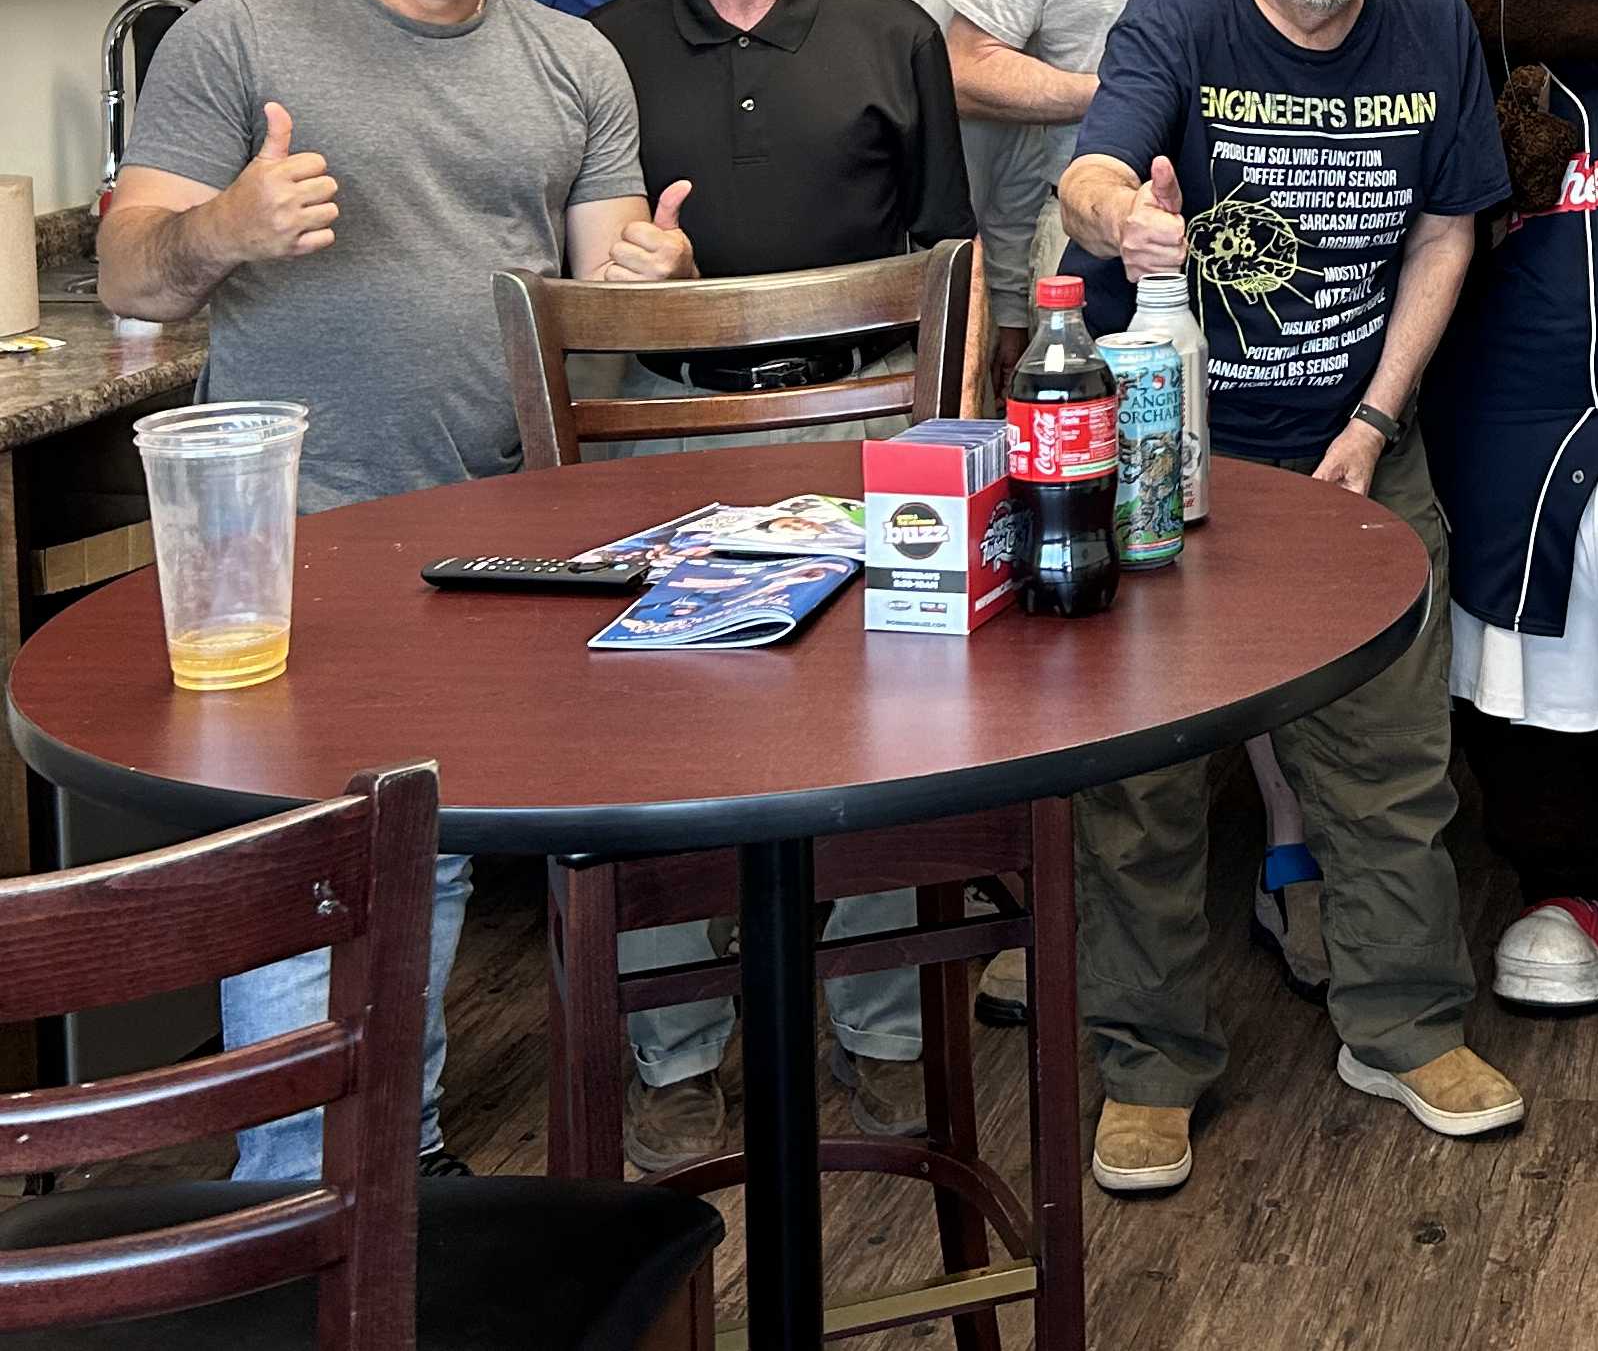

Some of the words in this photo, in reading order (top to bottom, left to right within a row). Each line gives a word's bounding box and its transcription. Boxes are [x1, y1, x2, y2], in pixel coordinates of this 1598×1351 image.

[1200, 85, 1347, 129] ENGINEER'S
[1354, 91, 1437, 128] BRAIN
[1212, 140, 1266, 164] PROBLEM
[1268, 147, 1319, 166] SOLVING
[1320, 148, 1383, 167] FUNCTION
[1243, 166, 1285, 186] COFFEE
[1287, 169, 1346, 187] LOCATION
[1349, 170, 1397, 187] SENSOR
[1270, 190, 1335, 209] SCIENTIFIC
[1336, 188, 1413, 209] CALCULATOR
[1300, 213, 1358, 231] SARCASM
[1360, 210, 1407, 231] CORTEX
[1323, 262, 1368, 283] MOSTLY
[1281, 319, 1321, 336] DISLIKE
[1322, 314, 1340, 332] FOR
[1245, 343, 1300, 362] POTENTIAL
[1288, 361, 1305, 378] BS
[1306, 352, 1349, 376] SENSOR
[1306, 373, 1344, 387] TAPE?
[883, 520, 950, 544] buzz
